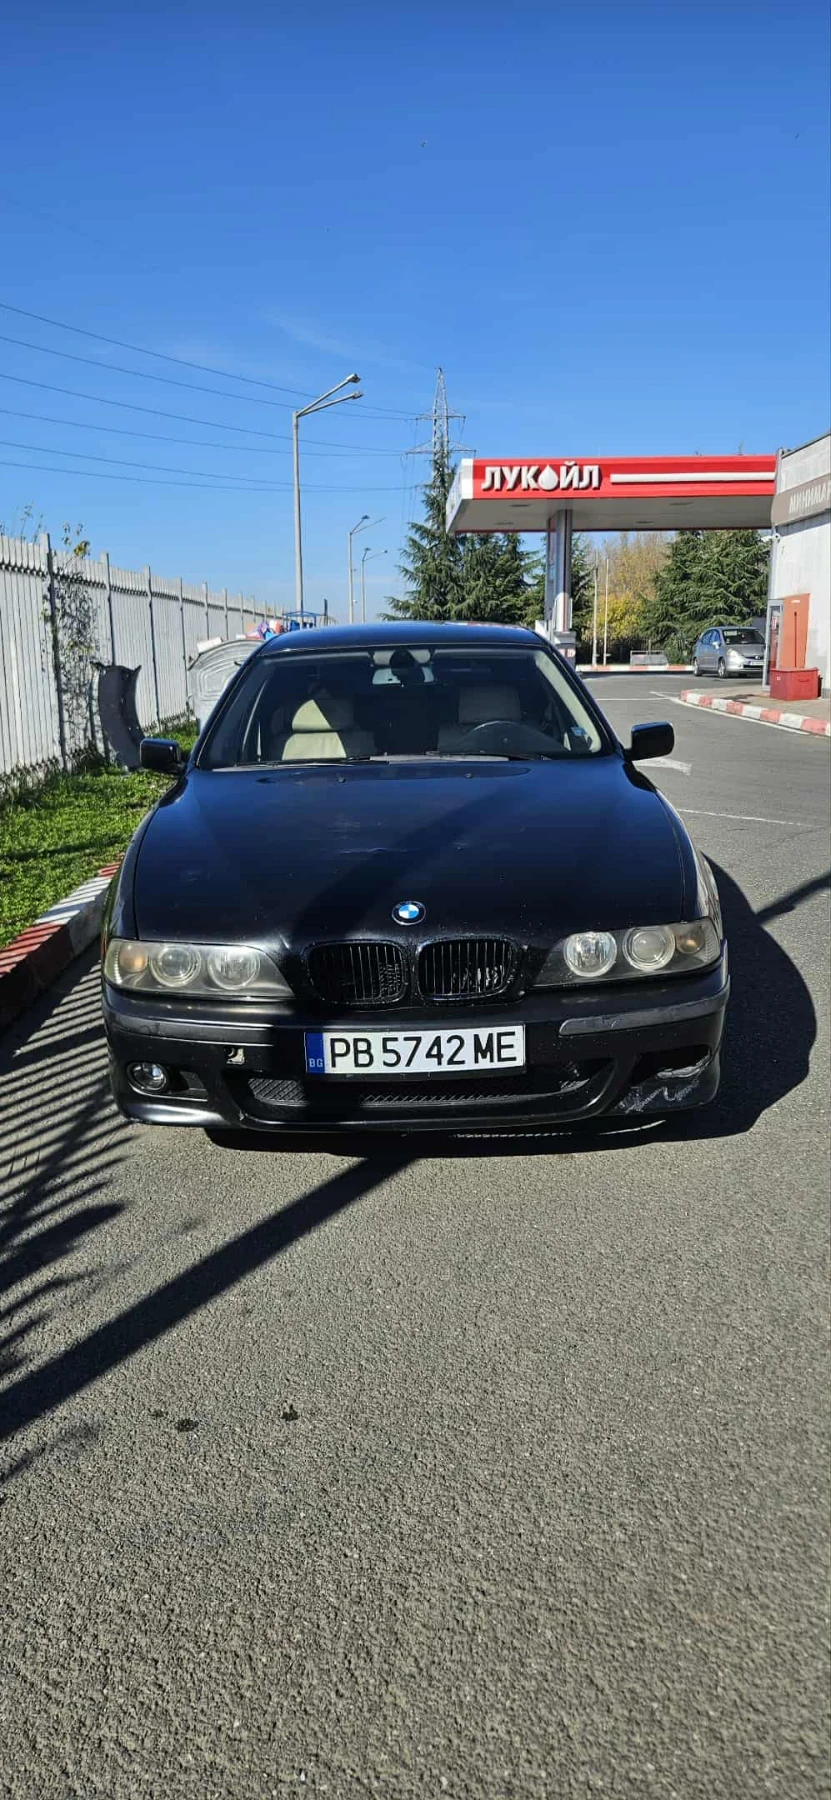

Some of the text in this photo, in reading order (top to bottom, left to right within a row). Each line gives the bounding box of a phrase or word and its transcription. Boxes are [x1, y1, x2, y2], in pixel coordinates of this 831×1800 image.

[481, 460, 601, 491] ЛУКОЙЛ
[309, 1058, 323, 1068] BG
[329, 1031, 517, 1068] PB 5742 ME
